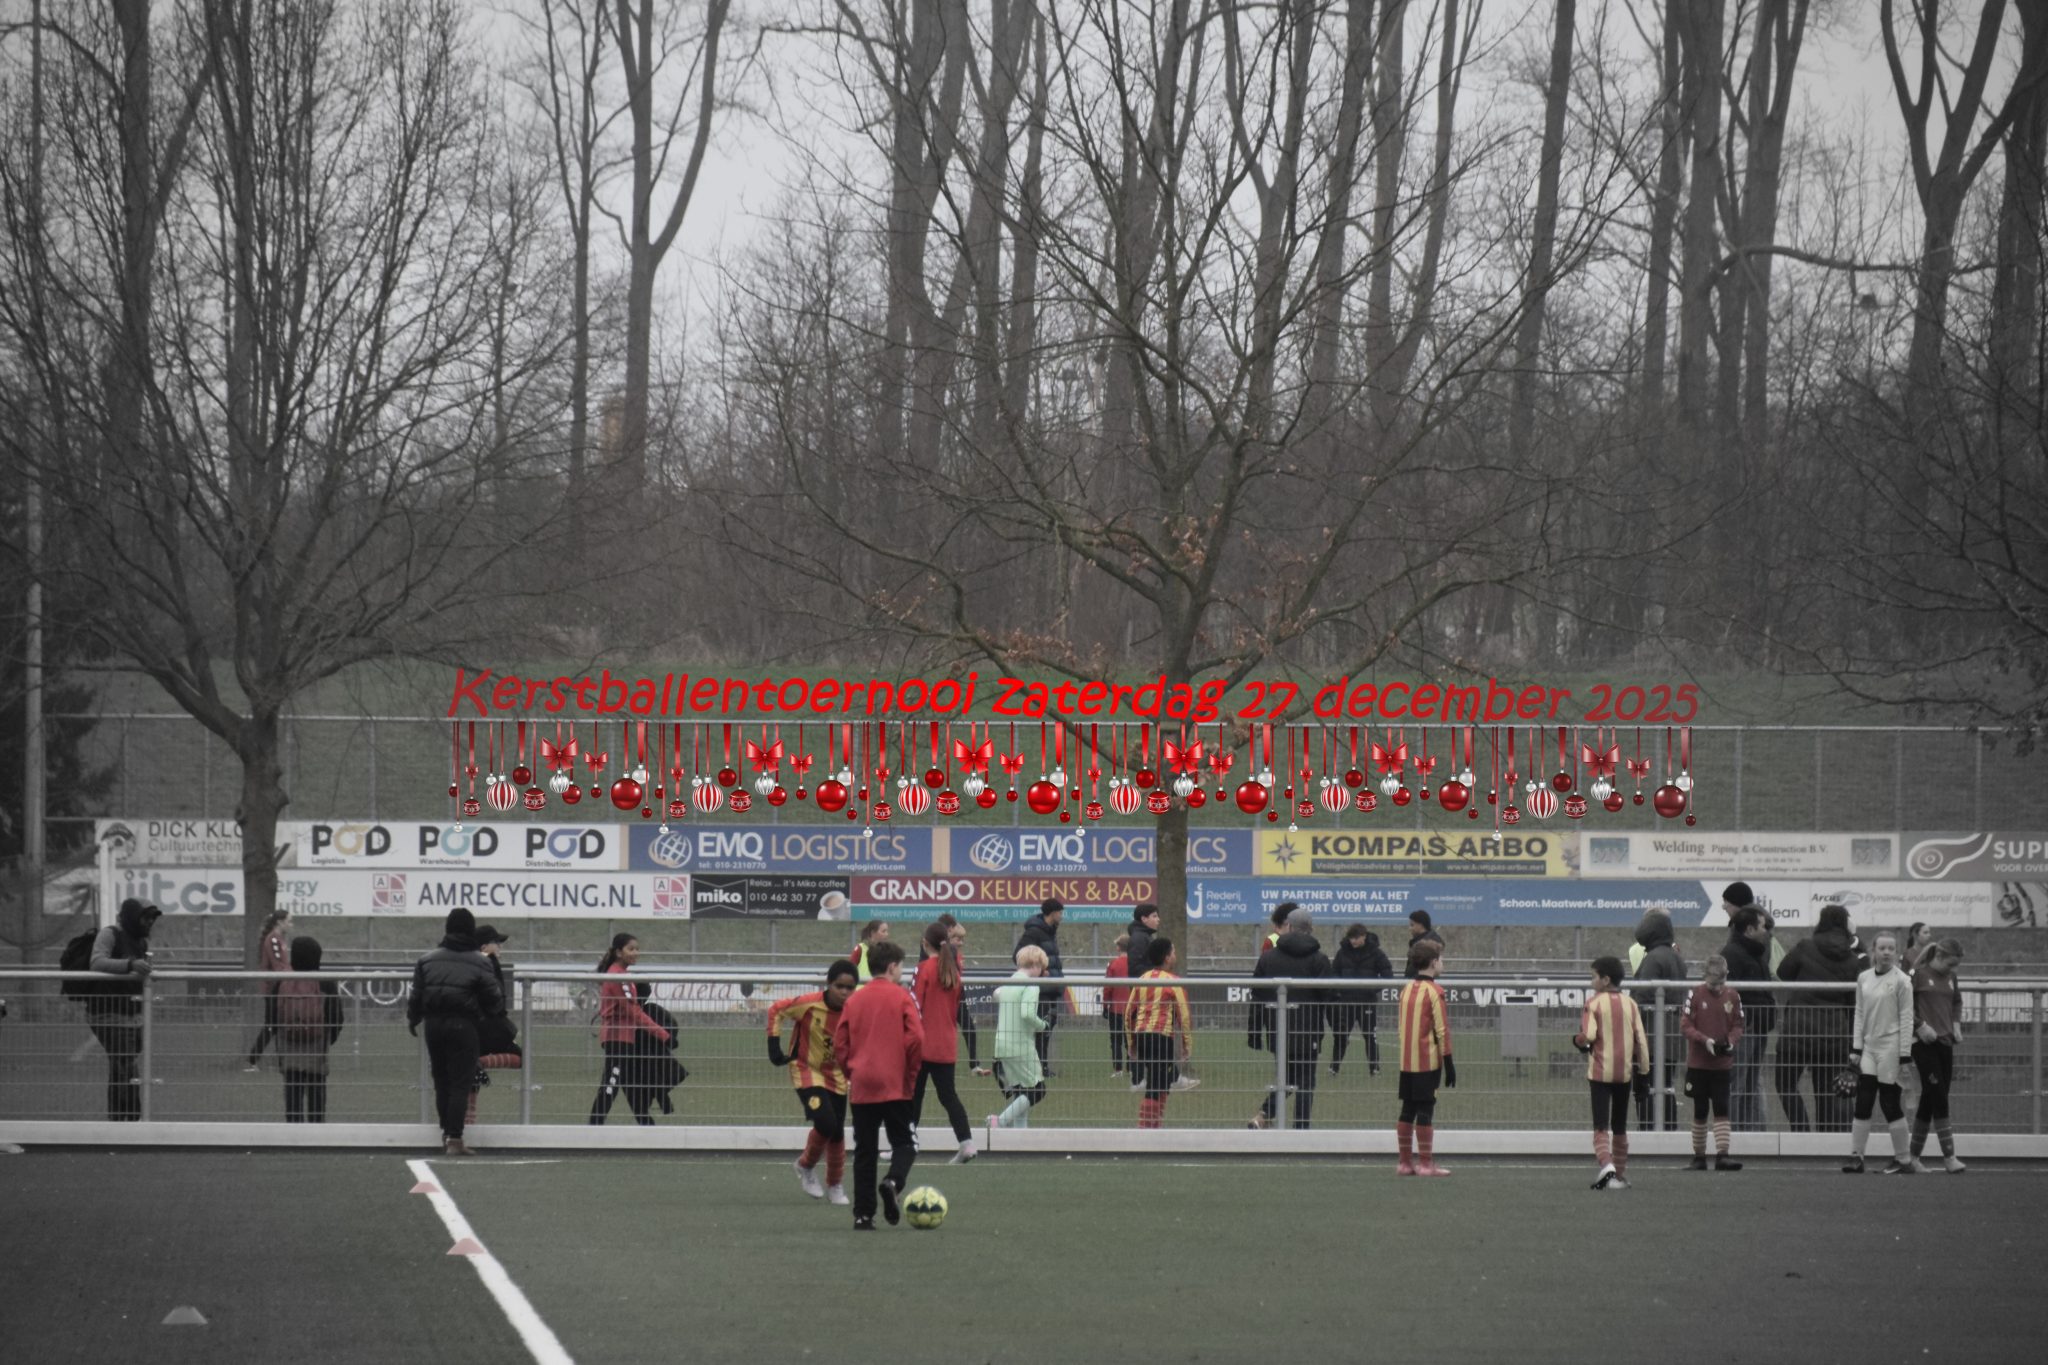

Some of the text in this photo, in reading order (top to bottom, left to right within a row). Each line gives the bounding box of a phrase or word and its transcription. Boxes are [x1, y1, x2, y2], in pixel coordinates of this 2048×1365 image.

[149, 821, 243, 838] DICK KLO
[148, 838, 242, 852] Cultuurtechn
[698, 831, 906, 861] EMQ LOGISTICS
[1020, 835, 1227, 864] EMQ LOGIICS
[1311, 836, 1548, 857] KOMPAS ARBO
[1652, 840, 1705, 856] Welding
[1993, 840, 2048, 859] SUP
[837, 863, 906, 872] emqlogistics.com
[1020, 864, 1087, 872] tel: 010-2310770
[1993, 863, 2022, 873] VOOR
[276, 880, 319, 897] ergy
[797, 879, 816, 887] Miko
[818, 879, 846, 888] coffee
[869, 879, 1152, 901] GRANDO KEUKENS & BAD
[418, 882, 641, 908] AMRECYCLING.NL
[697, 889, 742, 903] miko
[750, 893, 817, 901] 010 462 30 77
[1206, 890, 1241, 902] Rederij
[1261, 890, 1409, 900] UW PARTNER VOOR AL HET
[1812, 893, 1841, 902] Arcus
[276, 899, 343, 915] utions
[1206, 902, 1247, 913] de Jong
[1261, 902, 1402, 913] TRPORT OVER WATER
[1769, 899, 1800, 918] lean
